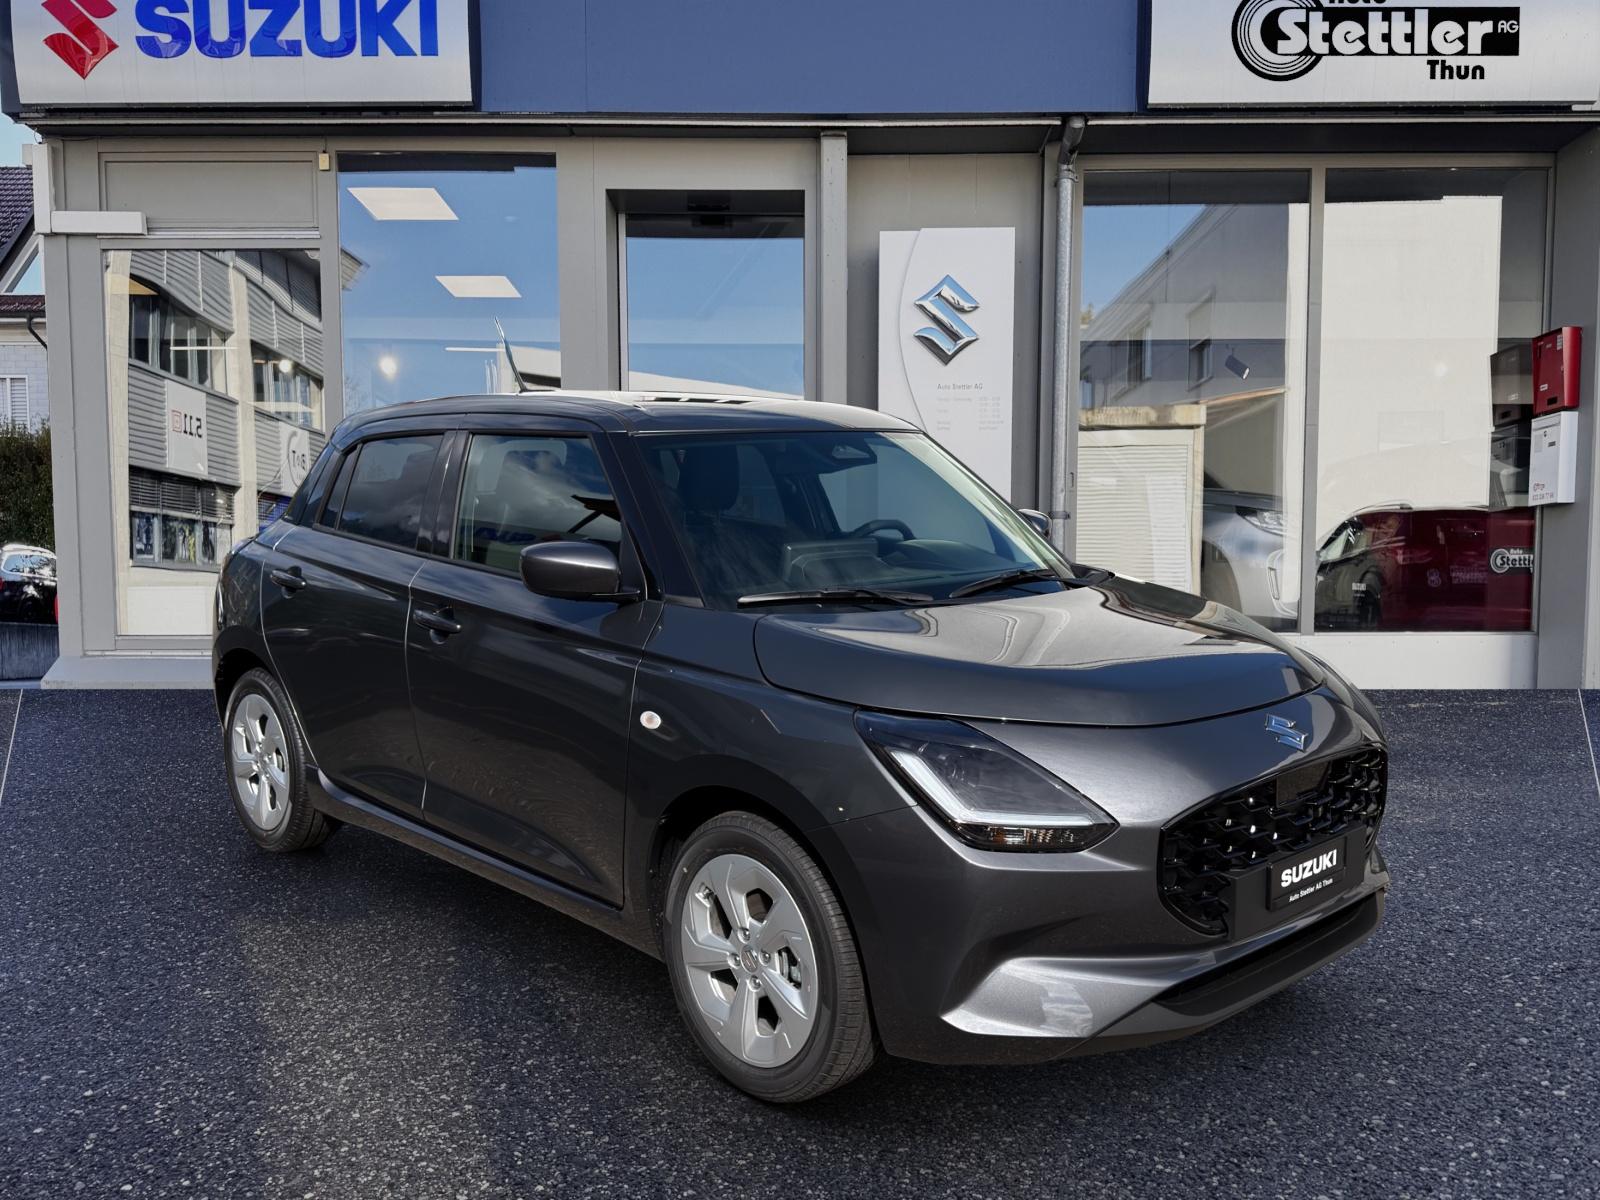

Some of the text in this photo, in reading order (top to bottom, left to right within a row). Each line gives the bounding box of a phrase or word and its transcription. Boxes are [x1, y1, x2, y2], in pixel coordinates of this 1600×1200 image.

[135, 0, 439, 58] SUZUKI
[1277, 8, 1519, 55] Stettler AG
[1427, 59, 1485, 80] Thun
[1281, 849, 1337, 887] SUZUKI
